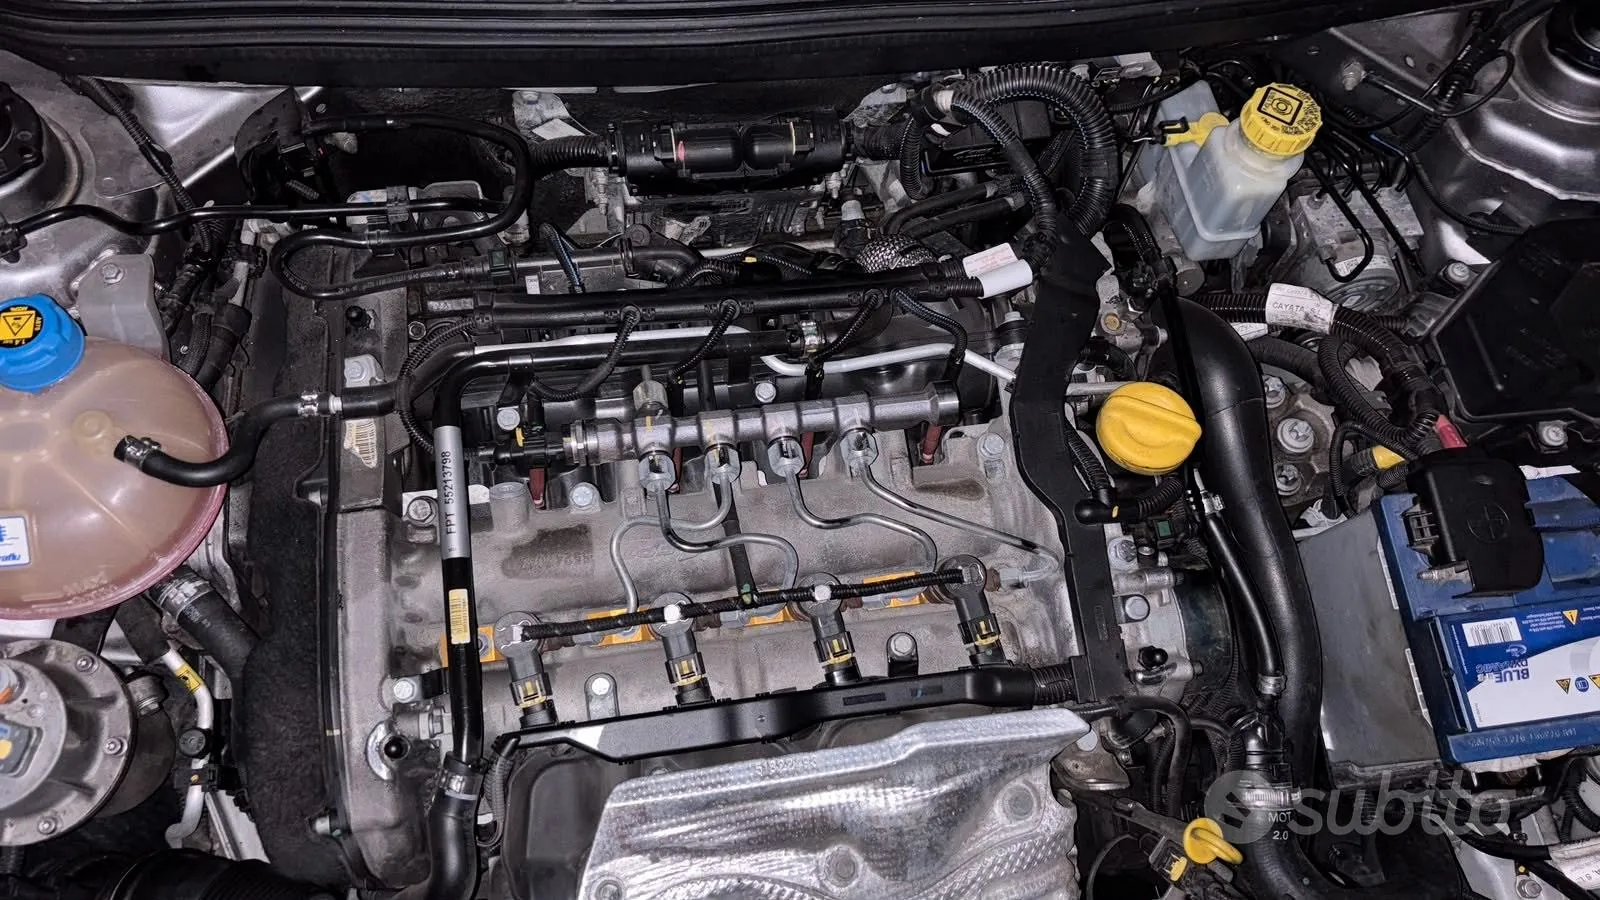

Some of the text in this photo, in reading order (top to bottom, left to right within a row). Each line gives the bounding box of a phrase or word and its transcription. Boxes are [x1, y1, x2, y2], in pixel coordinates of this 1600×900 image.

[441, 451, 455, 505] 55213798
[445, 512, 456, 535] FPT
[1475, 658, 1528, 673] DYNAMIC
[1493, 668, 1530, 683] BLUE
[1268, 811, 1292, 823] MOT
[1272, 830, 1289, 840] 2.0
